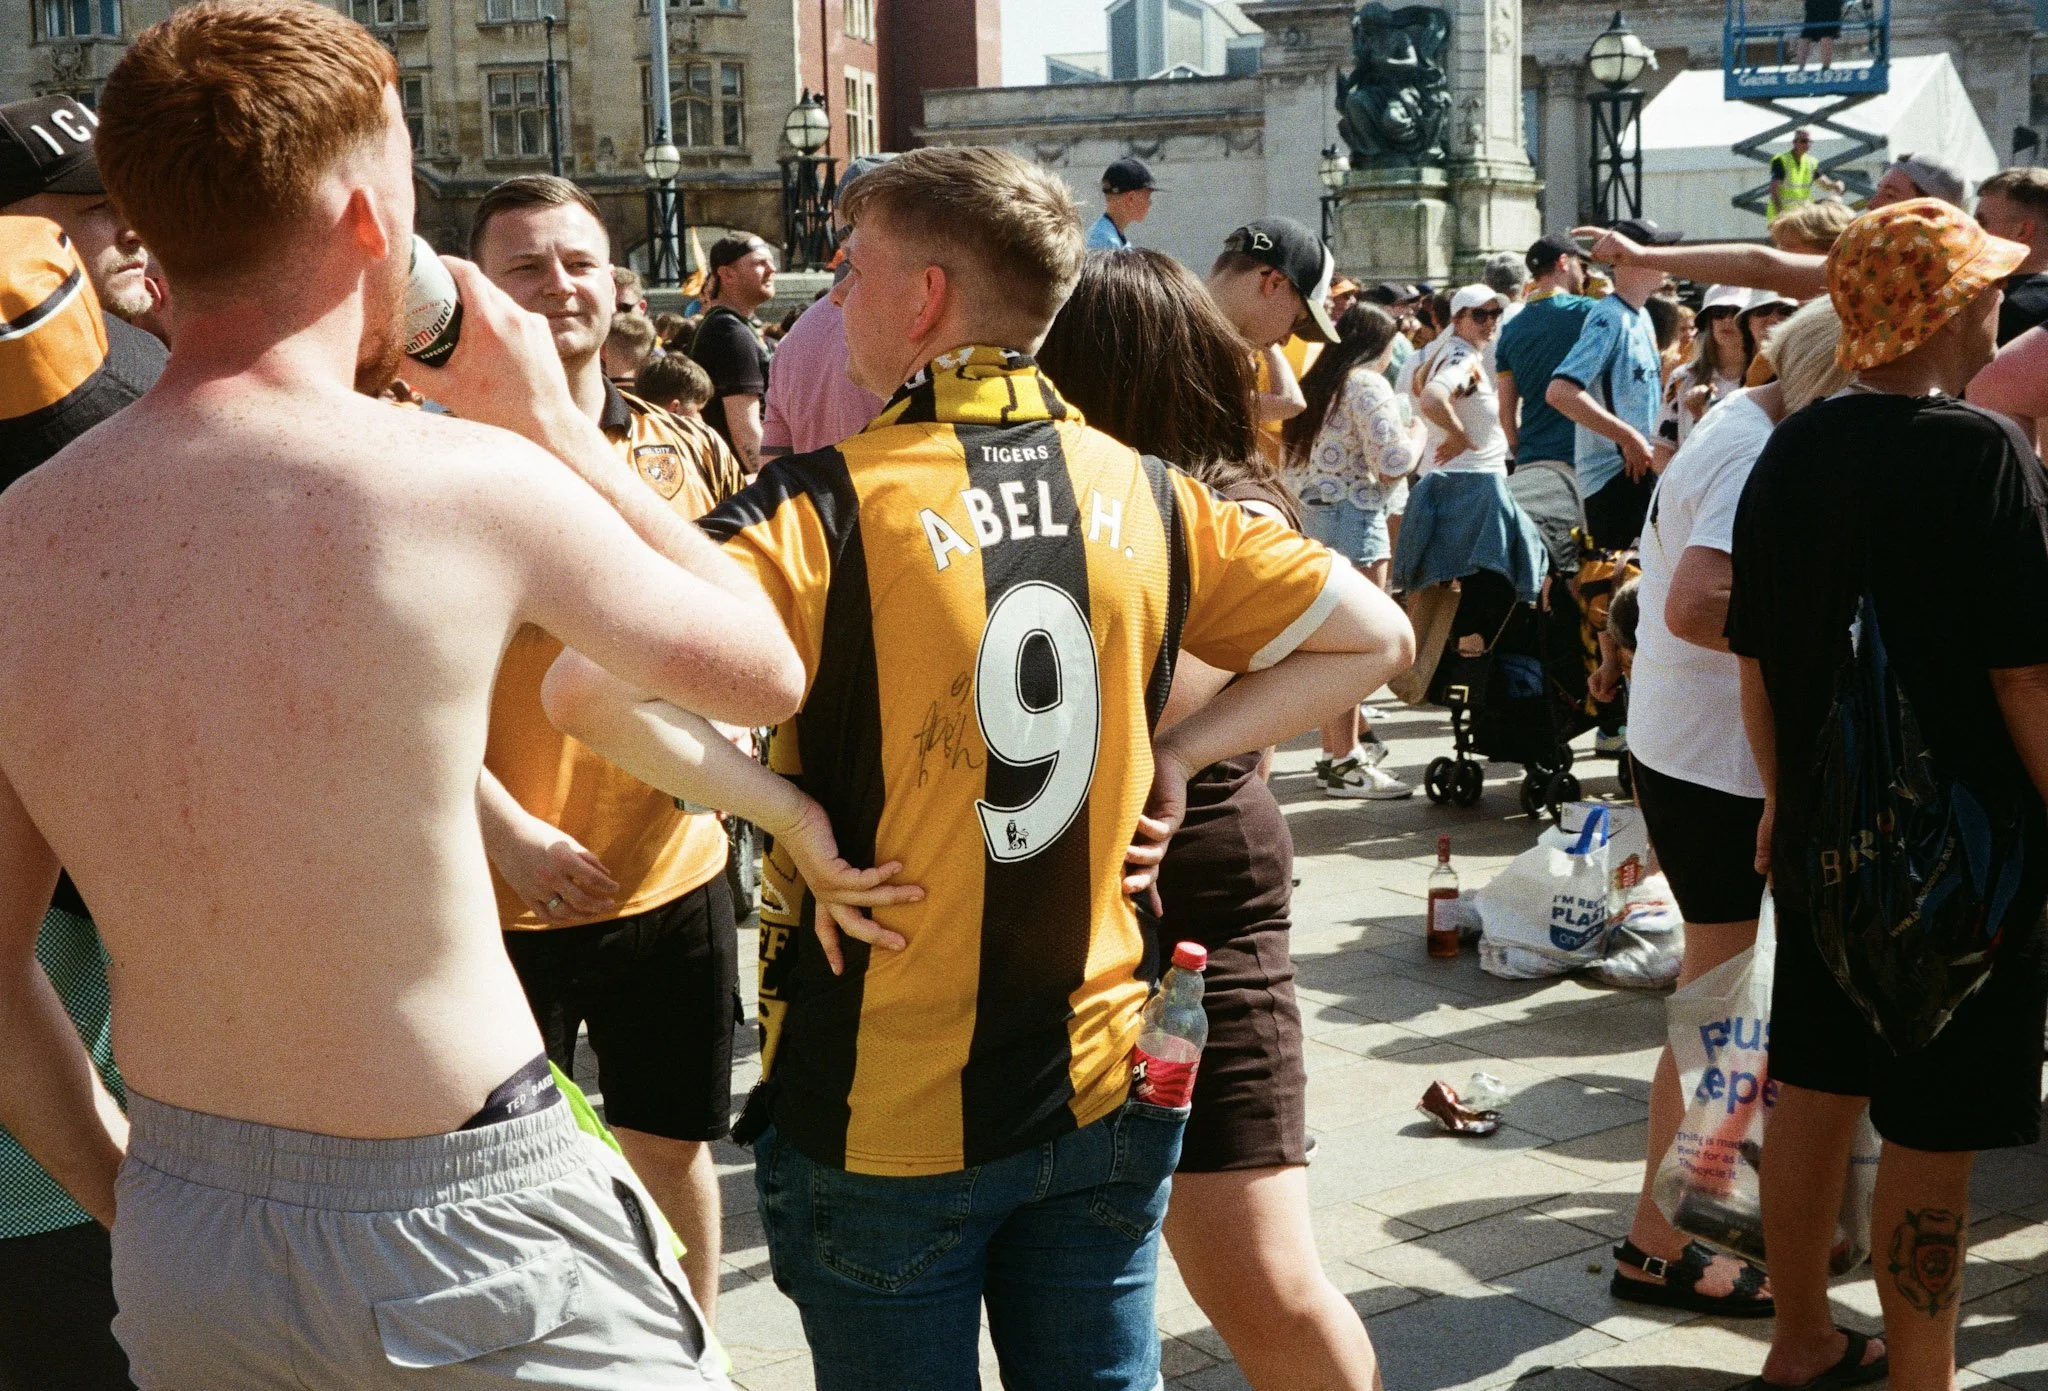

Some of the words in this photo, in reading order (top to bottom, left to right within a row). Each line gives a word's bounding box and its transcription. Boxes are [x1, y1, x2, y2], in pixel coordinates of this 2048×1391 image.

[981, 445, 1049, 462] TIGERS
[919, 479, 1068, 572] ABEL
[974, 580, 1101, 863] 9
[505, 1093, 527, 1114] TED
